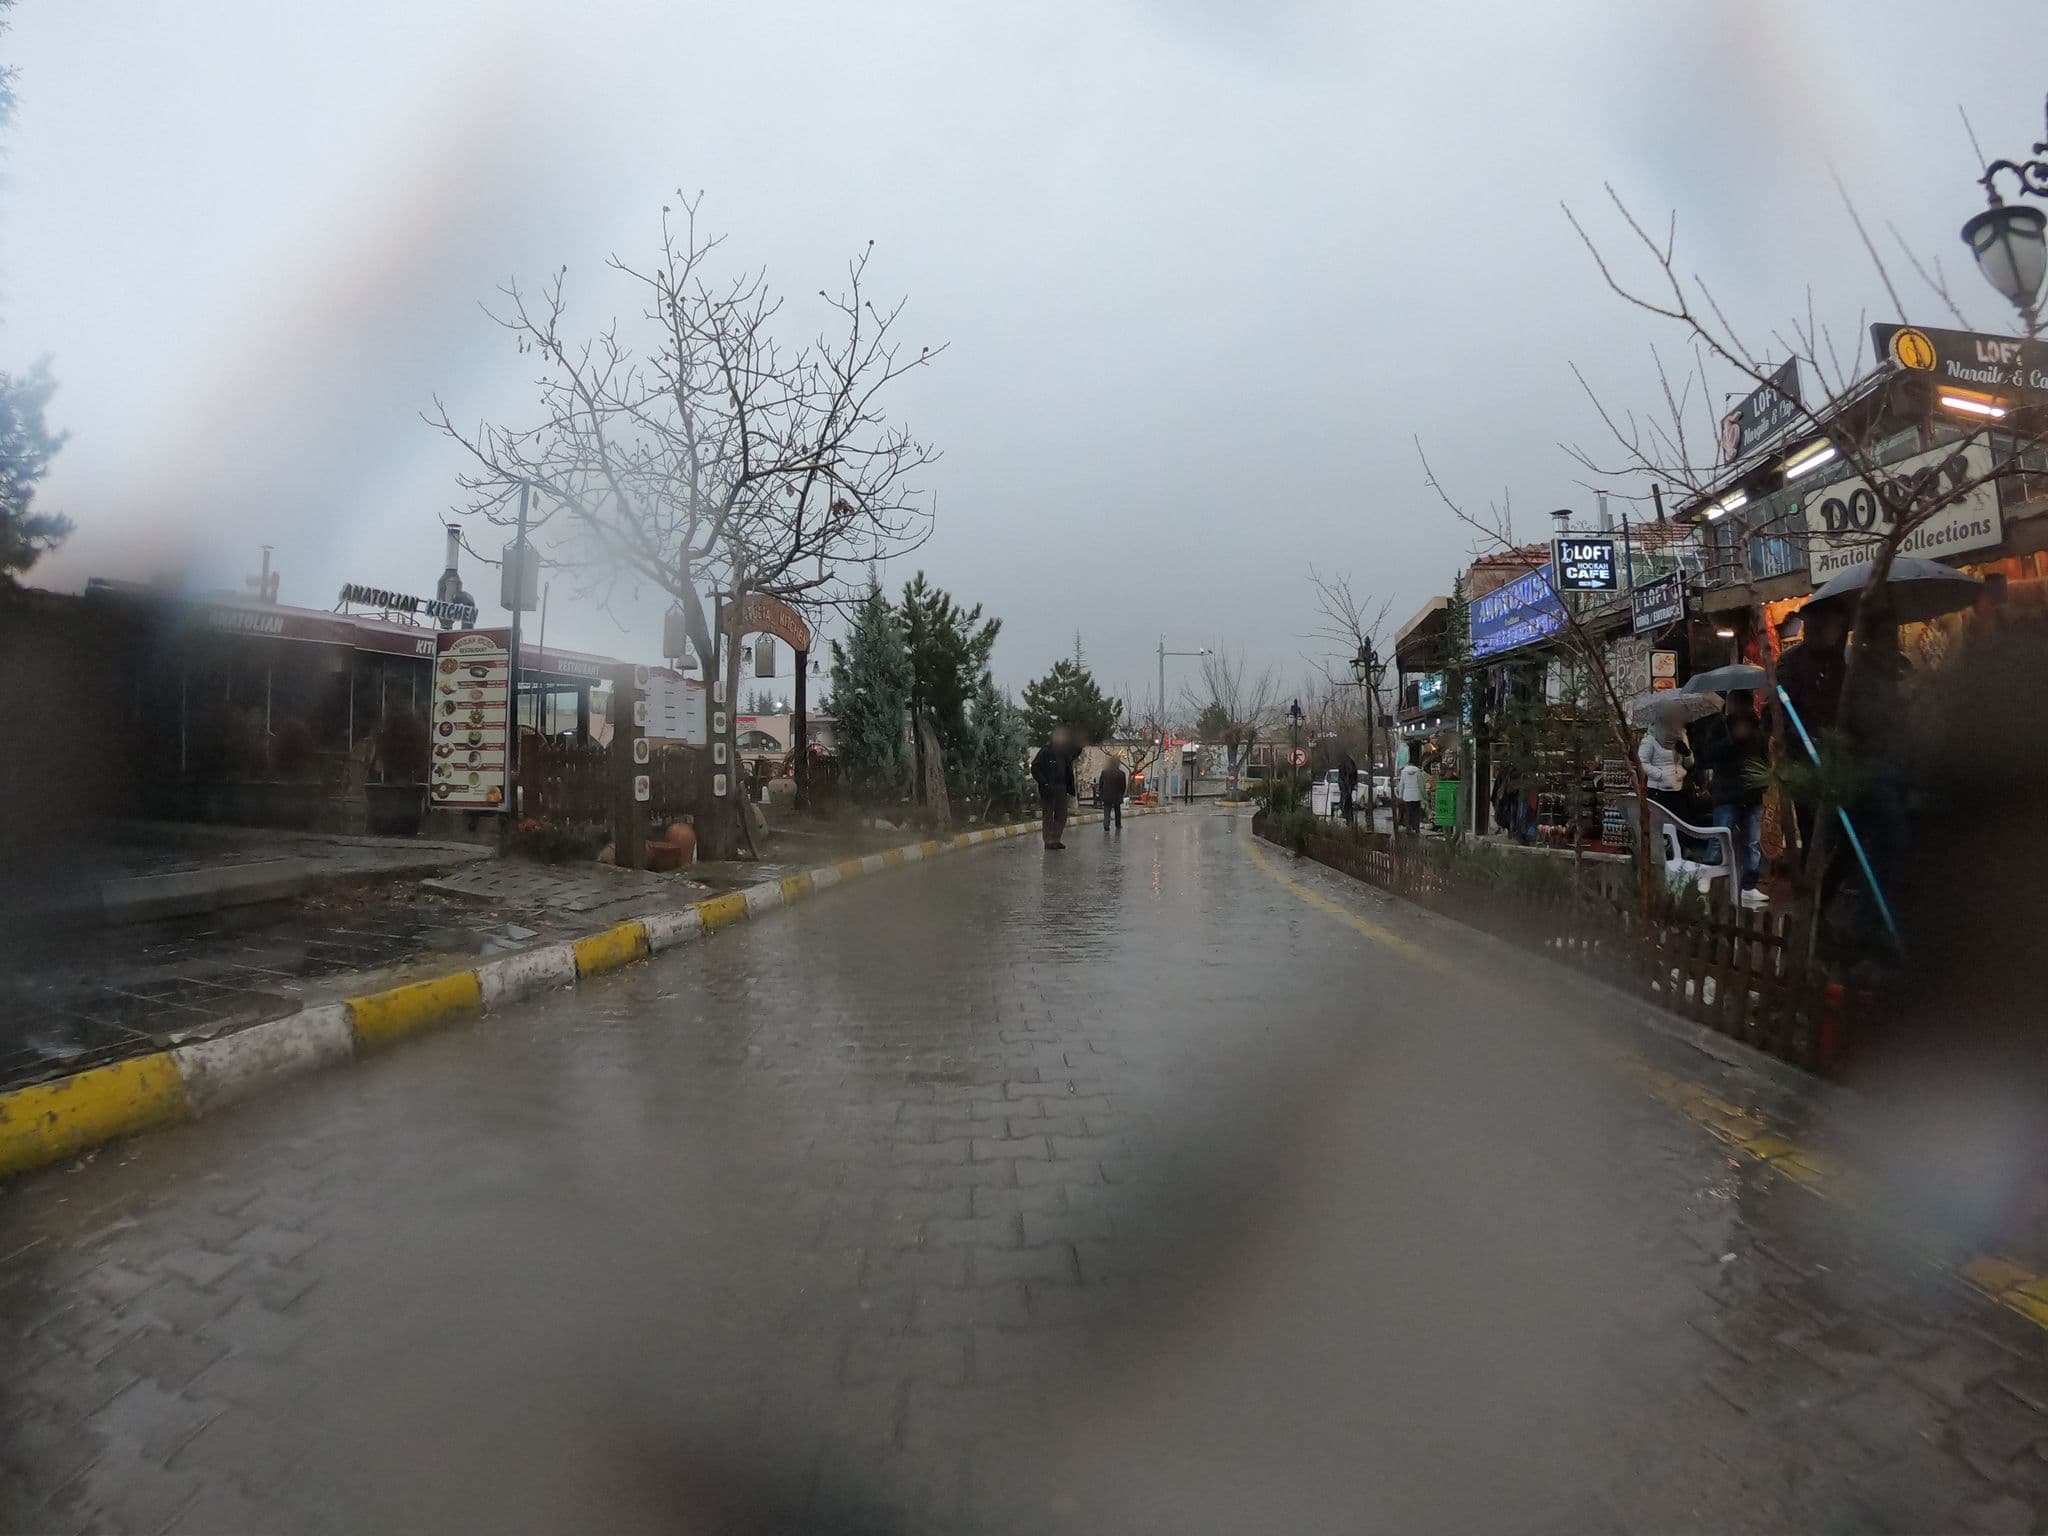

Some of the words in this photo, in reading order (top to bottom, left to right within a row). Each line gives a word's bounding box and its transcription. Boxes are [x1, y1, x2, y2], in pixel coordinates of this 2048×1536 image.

[1976, 339, 2023, 367] LOFT
[1574, 545, 1612, 561] LOFT
[1566, 567, 1611, 579] CAFE
[339, 582, 420, 613] ANATOLIAN
[425, 599, 479, 625] KITCHEN
[1643, 583, 1668, 608] LOFT
